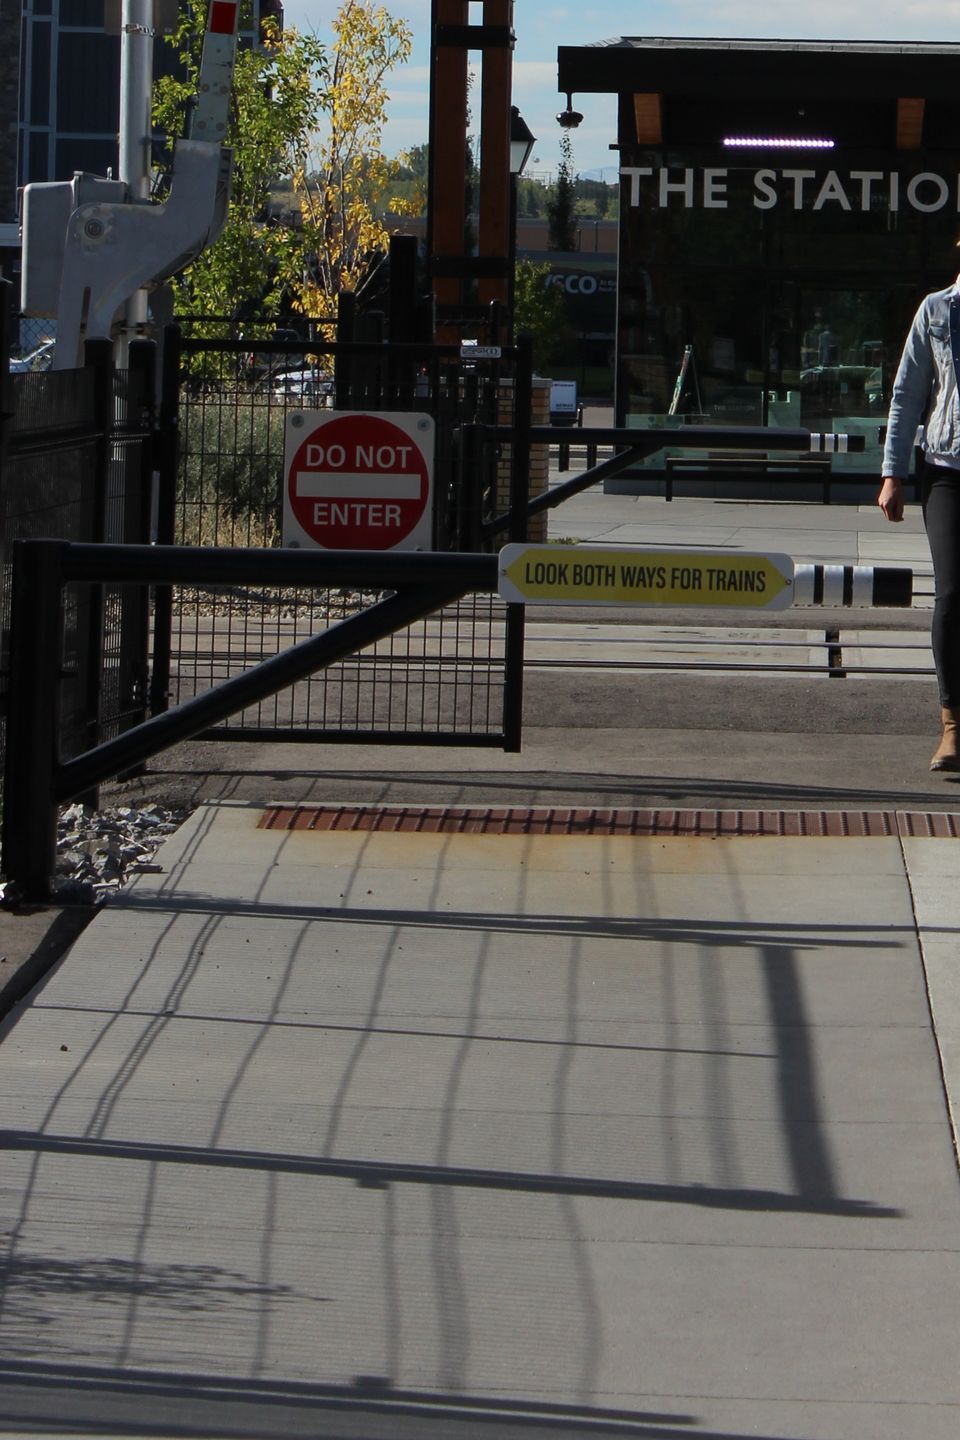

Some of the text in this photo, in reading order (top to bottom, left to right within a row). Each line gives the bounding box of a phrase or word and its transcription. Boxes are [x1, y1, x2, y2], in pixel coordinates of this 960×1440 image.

[620, 167, 728, 208] THE
[306, 444, 412, 469] DO NOT
[313, 503, 402, 527] ENTER
[525, 562, 766, 593] LOOK BOTH WAYS FOR TRAINS
